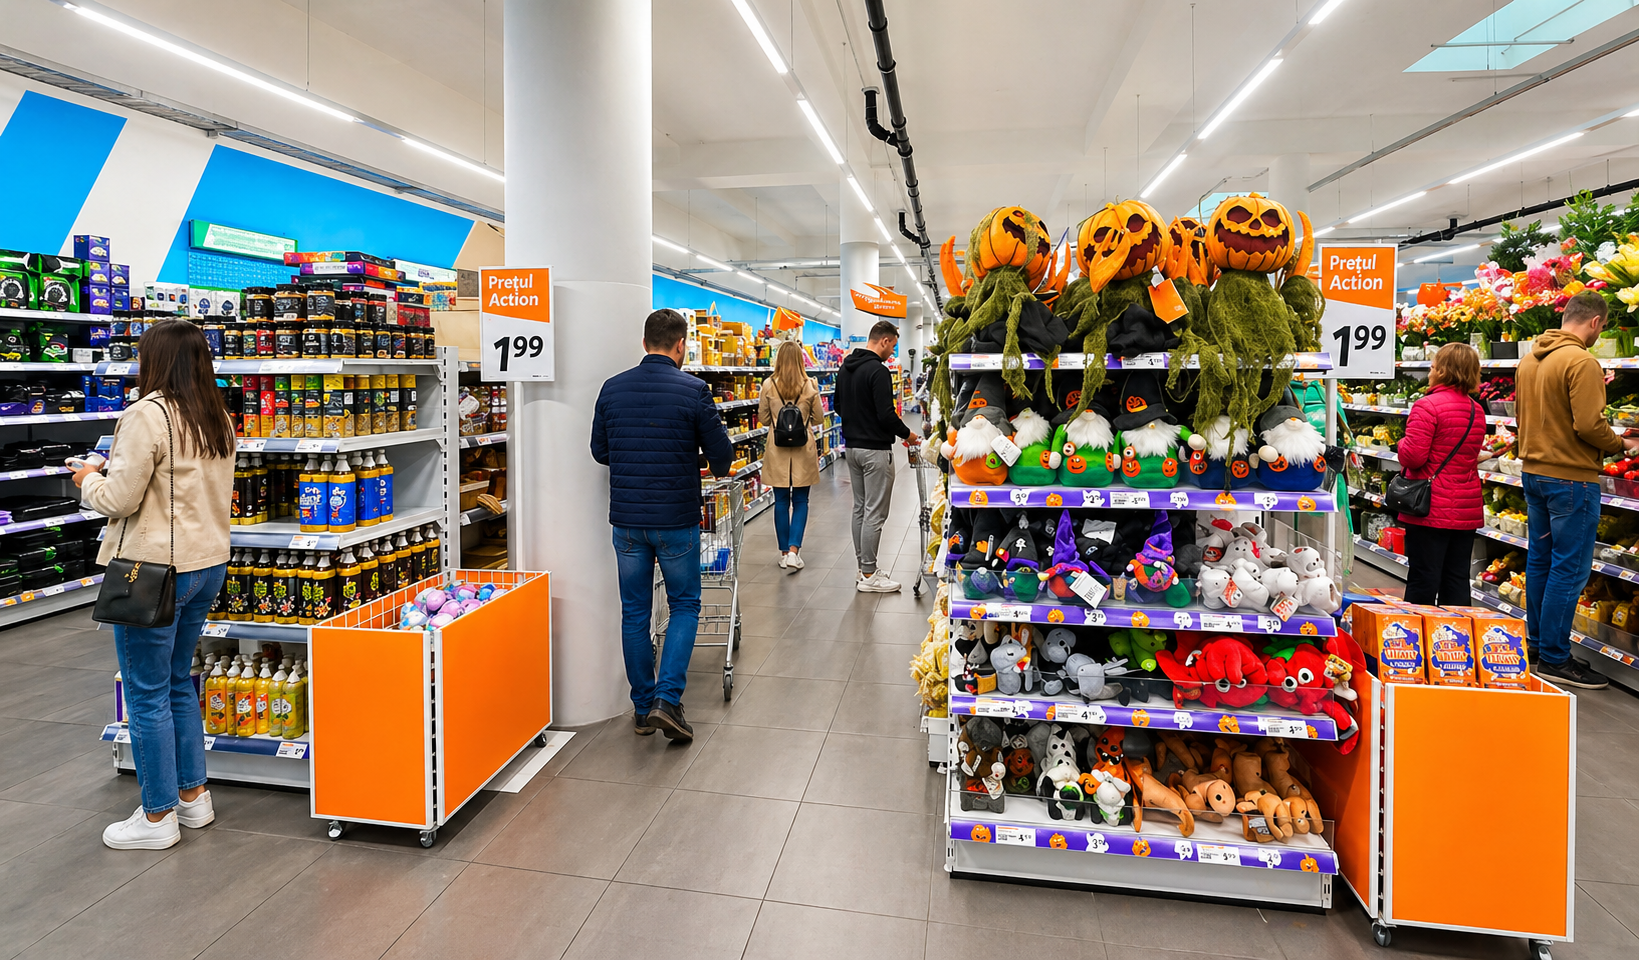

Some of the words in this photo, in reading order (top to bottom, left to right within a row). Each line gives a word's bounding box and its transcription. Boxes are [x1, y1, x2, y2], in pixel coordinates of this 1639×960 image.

[1330, 254, 1377, 274] Prețul
[488, 273, 533, 291] Prețul
[1329, 274, 1383, 290] Action
[488, 292, 539, 307] Action
